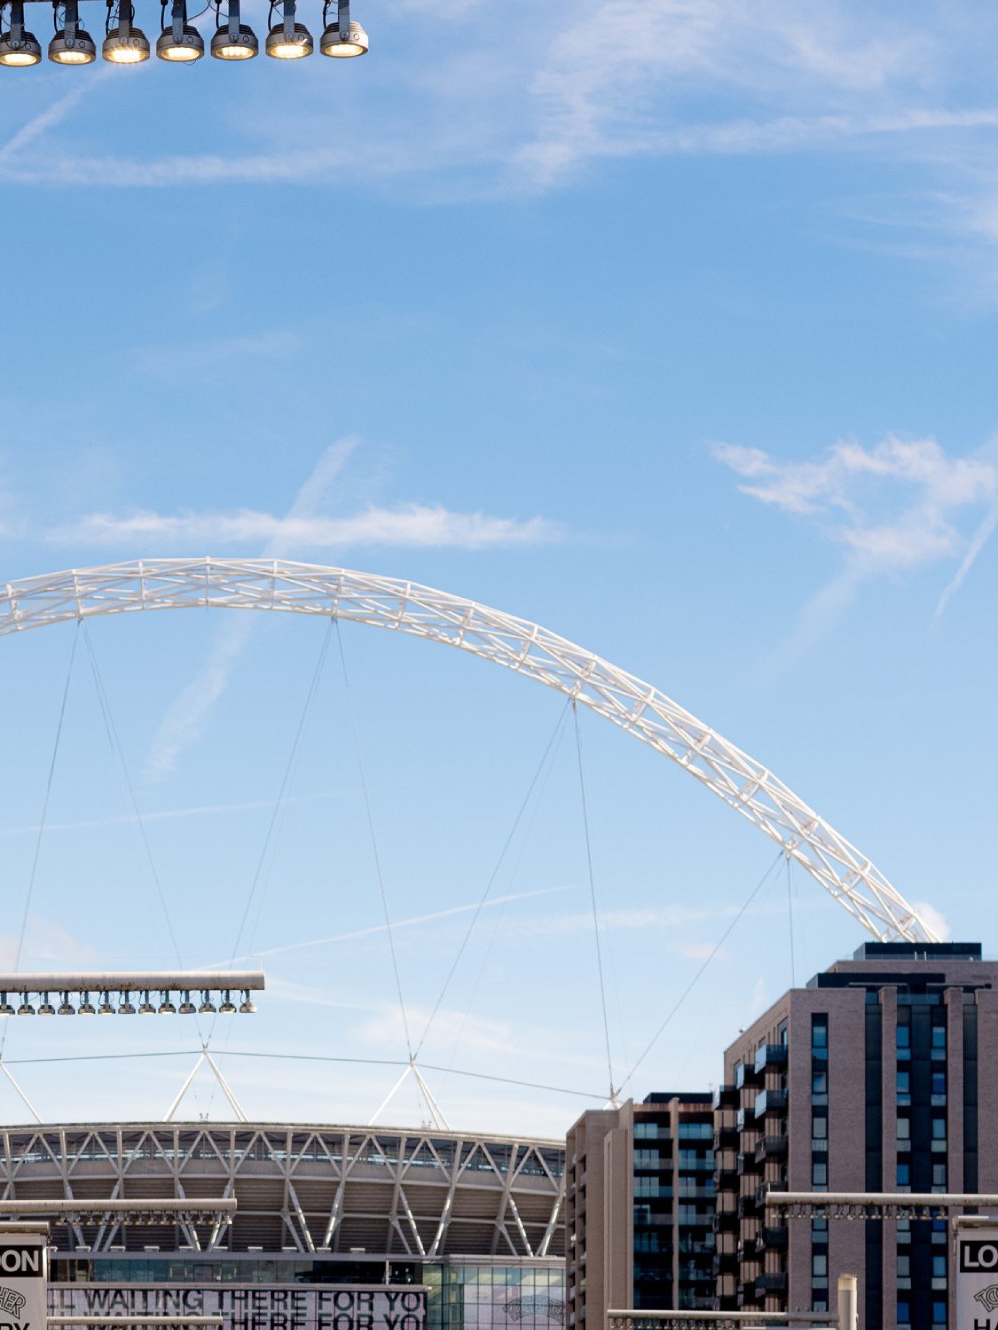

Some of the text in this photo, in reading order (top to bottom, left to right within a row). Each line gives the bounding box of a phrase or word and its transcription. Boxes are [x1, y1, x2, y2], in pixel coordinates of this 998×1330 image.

[84, 1290, 202, 1309] WAITING
[213, 1290, 307, 1311] THERE
[318, 1291, 375, 1312] FOR
